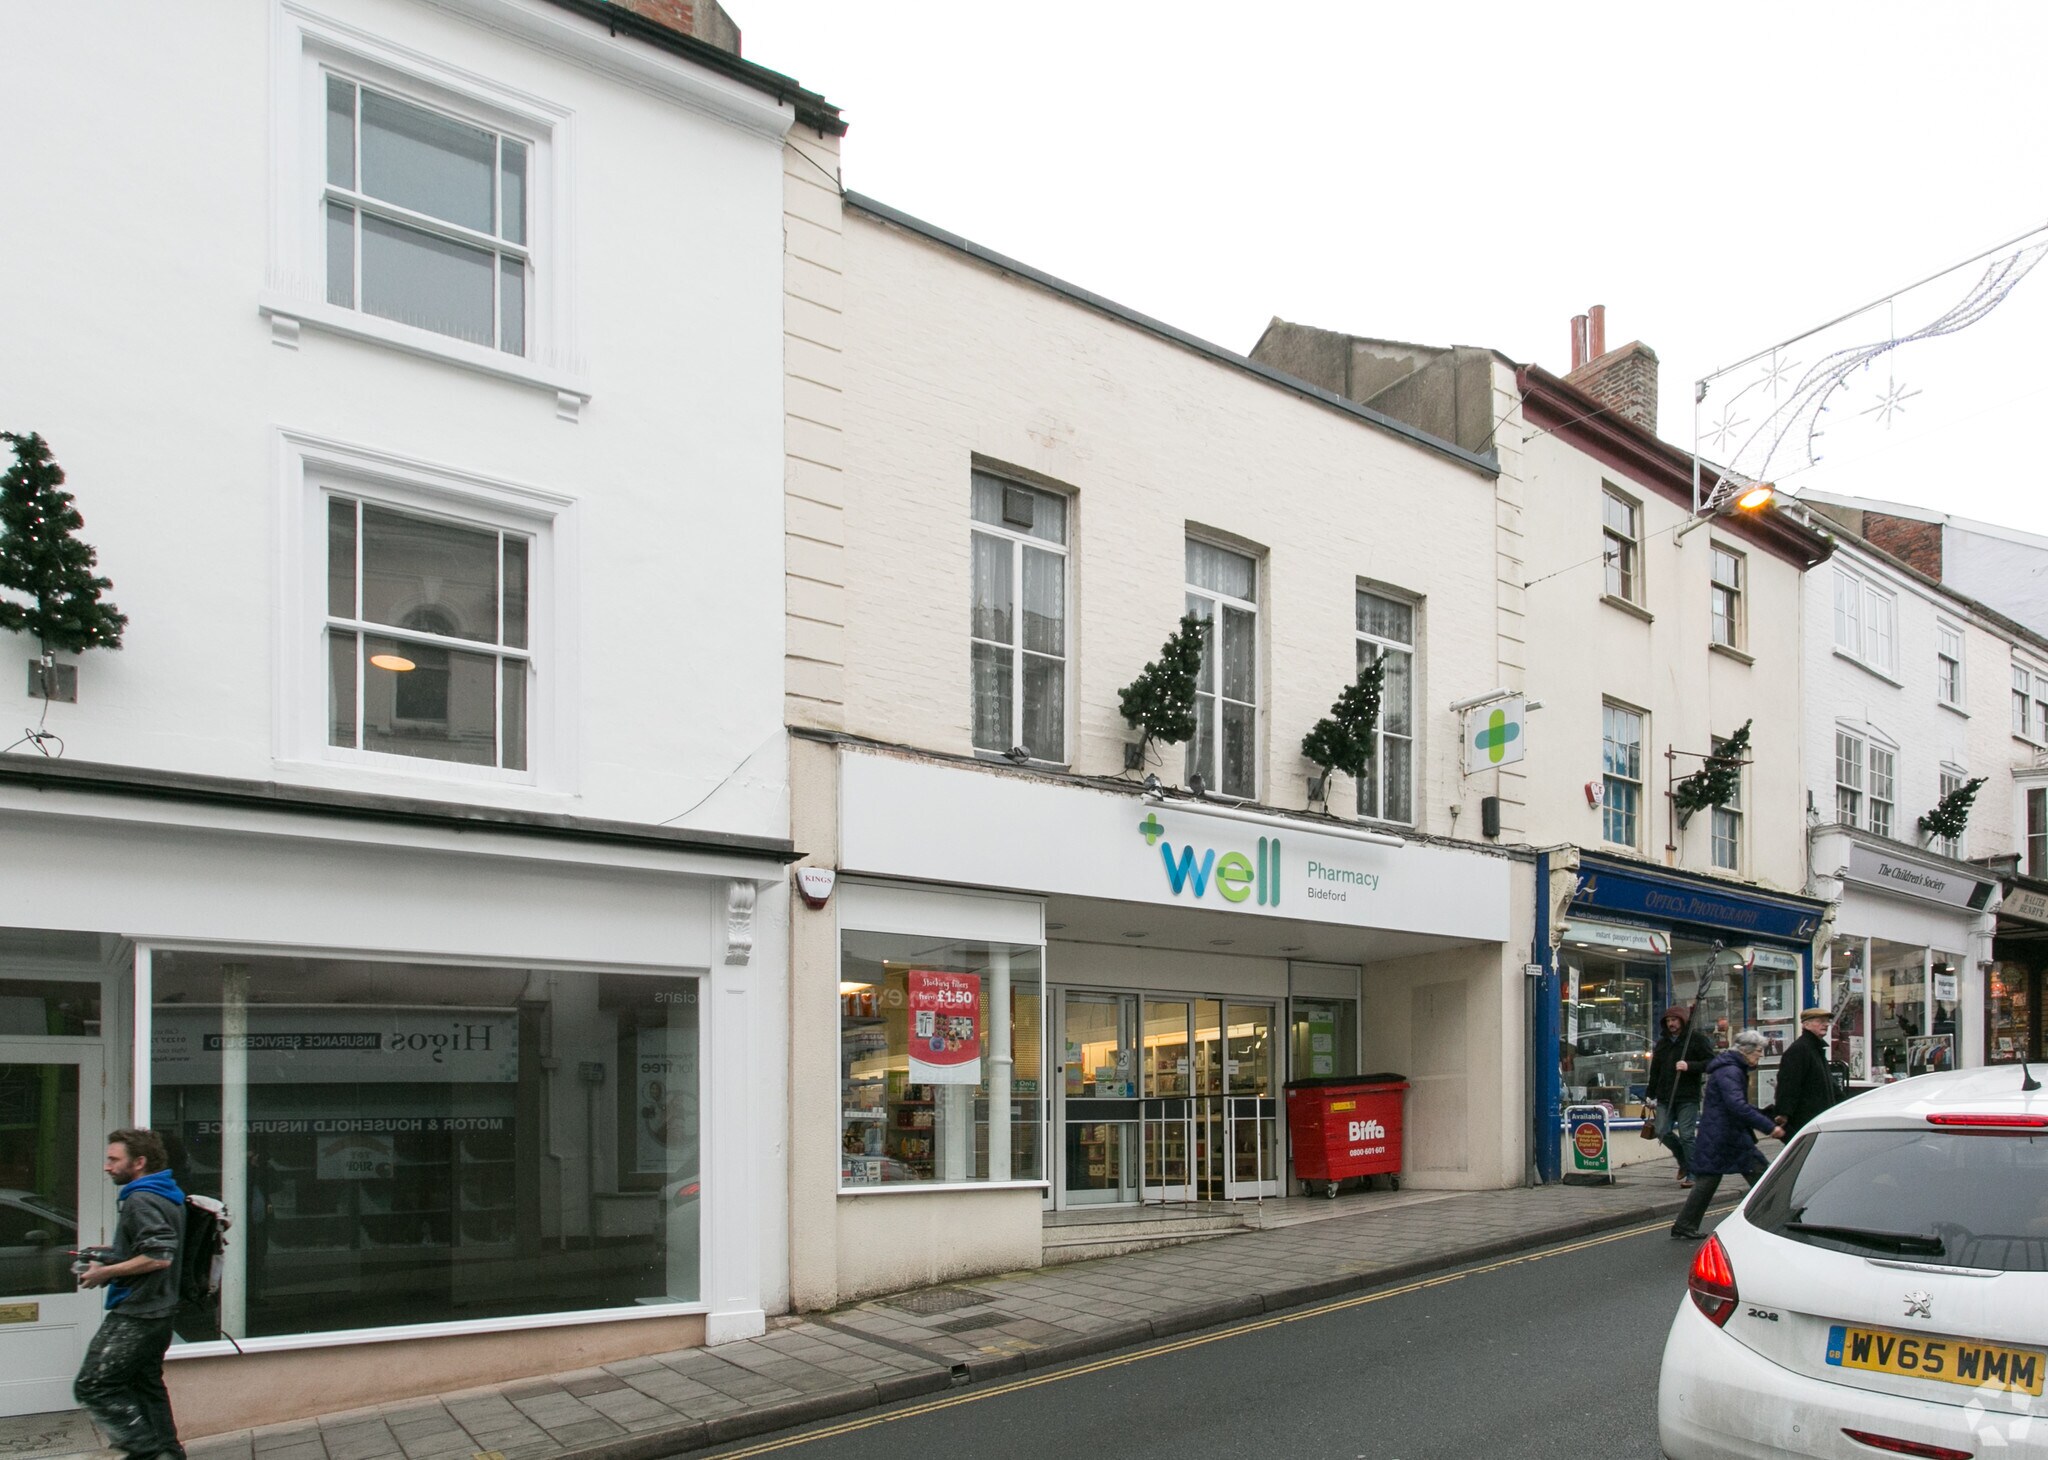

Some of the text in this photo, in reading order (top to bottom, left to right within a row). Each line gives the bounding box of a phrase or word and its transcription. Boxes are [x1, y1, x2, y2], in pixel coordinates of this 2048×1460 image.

[1161, 836, 1281, 907] well
[1307, 861, 1380, 891] Pharmacy
[1878, 863, 1946, 894] The Children's Society
[804, 874, 832, 884] KINGS
[1307, 887, 1347, 902] Bideford
[1595, 930, 1648, 944] instant passport photos
[923, 977, 969, 991] Stocking fillers
[918, 991, 936, 1000] from
[937, 989, 972, 1004] £1.50
[1019, 1080, 1036, 1088] Only
[1571, 1112, 1603, 1120] Available
[1348, 1119, 1385, 1142] Biffa
[1583, 1159, 1600, 1167] Here
[1747, 1308, 1779, 1322] 208
[1829, 1350, 1841, 1359] GB
[1851, 1332, 2037, 1388] WV65 WMM
